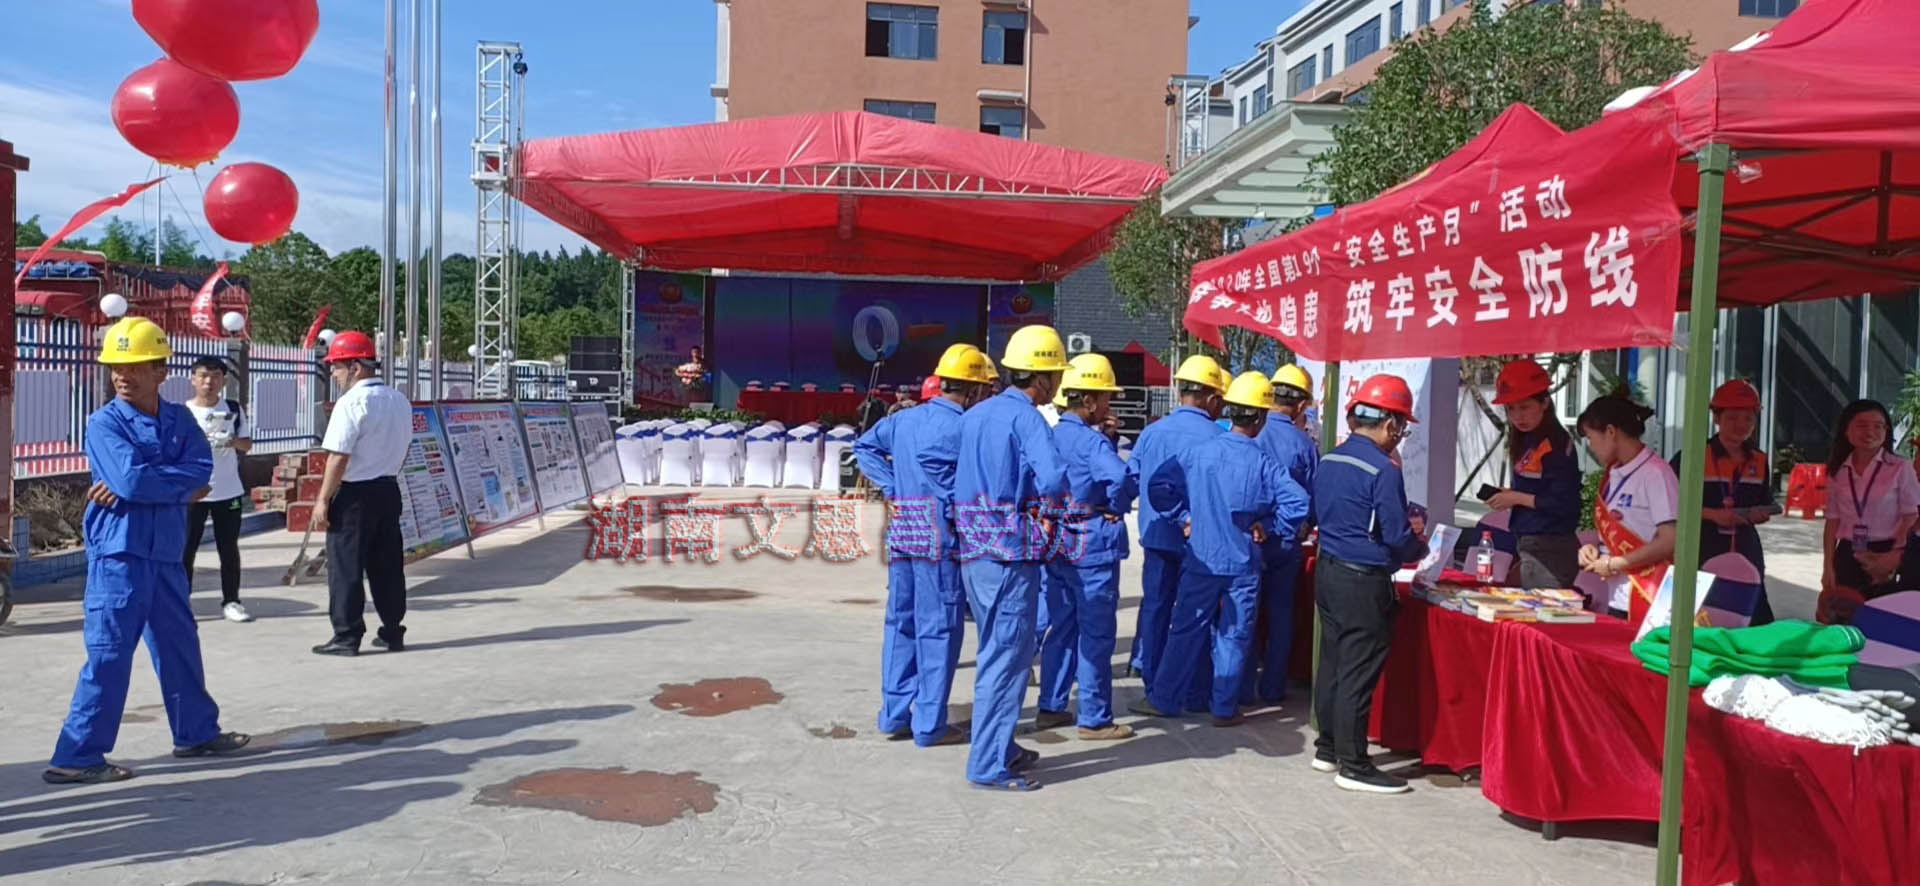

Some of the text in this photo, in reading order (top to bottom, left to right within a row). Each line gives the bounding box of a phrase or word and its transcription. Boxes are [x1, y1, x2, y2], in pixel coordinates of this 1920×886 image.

[1343, 225, 1639, 335] 筑牢安全防线
